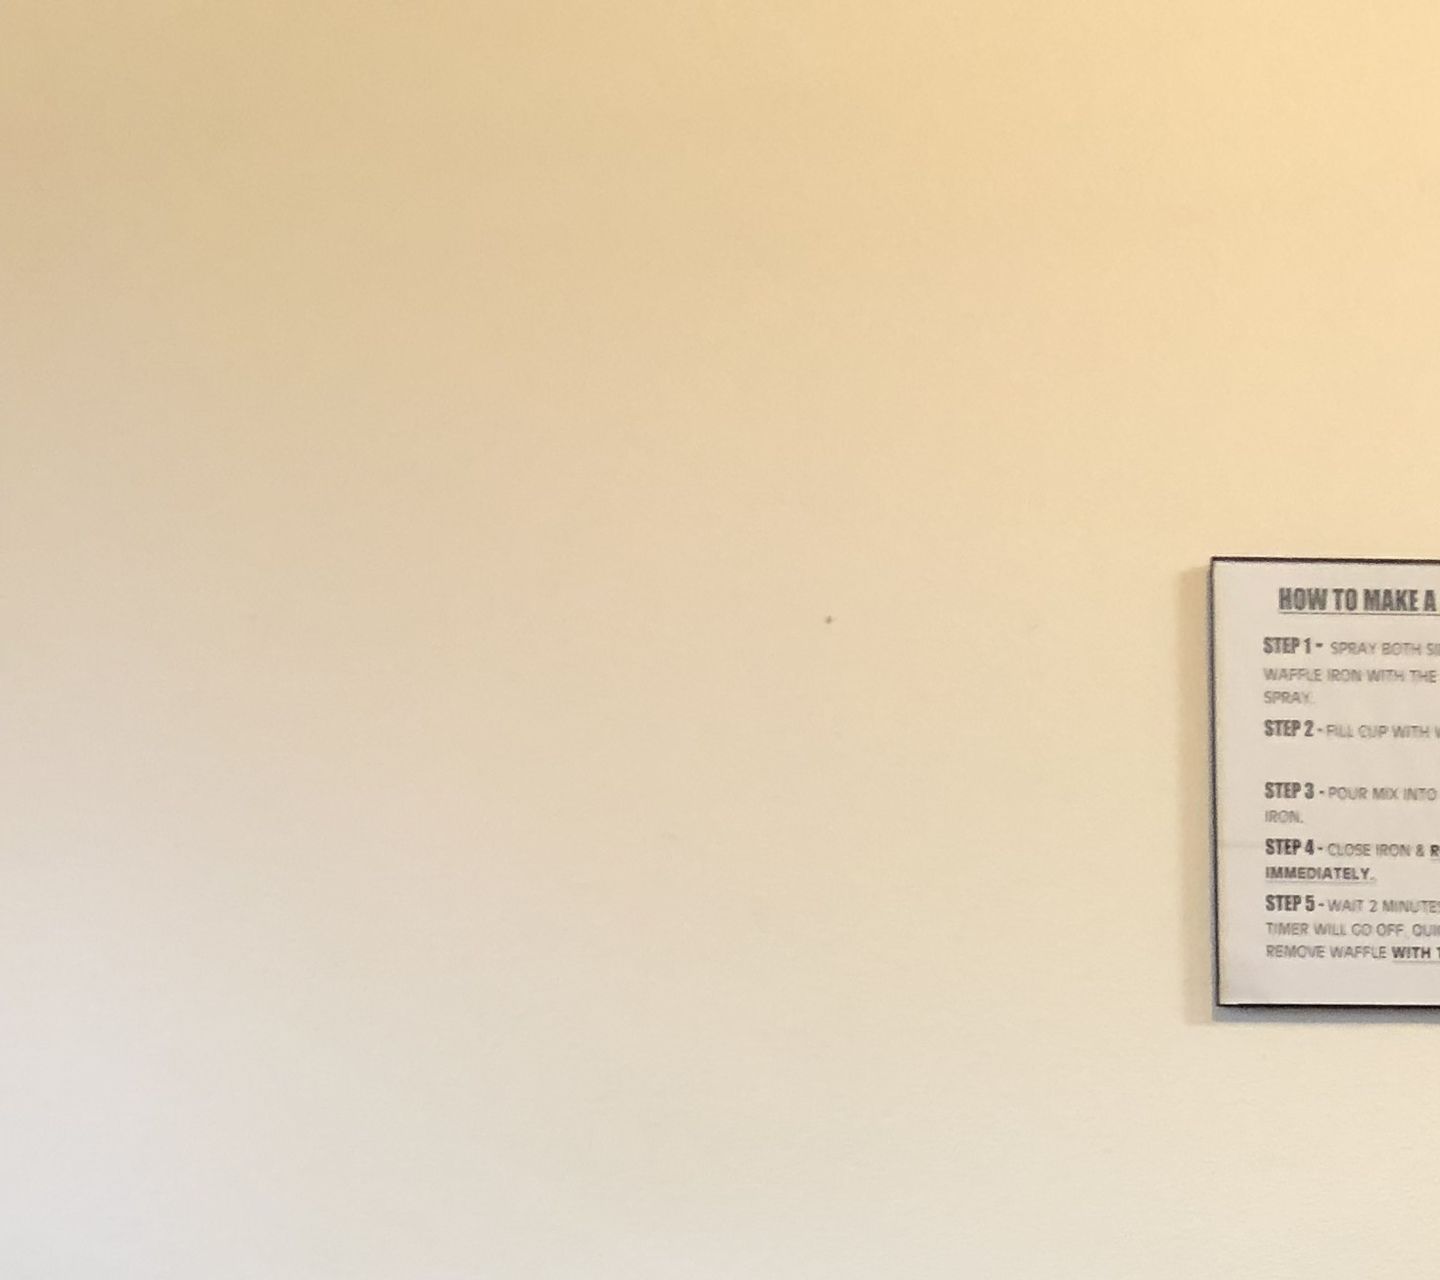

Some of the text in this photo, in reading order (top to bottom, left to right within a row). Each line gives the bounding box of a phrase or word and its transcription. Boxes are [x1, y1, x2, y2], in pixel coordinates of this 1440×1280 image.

[1278, 587, 1328, 611] HOW
[1333, 588, 1357, 611] TO
[1363, 588, 1418, 612] MAKE
[1423, 589, 1437, 612] A
[1263, 637, 1300, 654] STEP
[1304, 637, 1312, 654] 1
[1330, 641, 1377, 656] SPRAY
[1382, 642, 1422, 657] BOTH
[1263, 668, 1322, 682] WAFFLE
[1327, 668, 1362, 682] IRON
[1367, 669, 1405, 683] WITH
[1409, 669, 1437, 683] THE
[1264, 719, 1301, 737] STEP
[1304, 719, 1314, 737] 2
[1326, 724, 1355, 738] FILL
[1358, 724, 1388, 738] CUP
[1392, 725, 1430, 738] WITH
[1265, 782, 1301, 799] STEP
[1305, 782, 1314, 799] 3
[1328, 787, 1367, 800] POUR
[1373, 787, 1399, 800] MIX
[1403, 787, 1437, 801] INTO
[1265, 810, 1303, 824] IRON.
[1265, 838, 1302, 855] STEP
[1304, 839, 1315, 856] 4
[1327, 843, 1370, 857] CLOSE
[1375, 844, 1411, 857] IRON
[1415, 844, 1425, 857] &
[1265, 866, 1375, 881] IMMEDIATELY.
[1265, 895, 1302, 912] STEP
[1305, 895, 1315, 912] 5
[1328, 899, 1363, 913] WAIT
[1369, 900, 1378, 913] 2
[1266, 922, 1309, 936] TIMER
[1314, 922, 1347, 936] WILL
[1351, 923, 1372, 936] GO
[1266, 944, 1325, 958] REMOVE
[1330, 945, 1387, 959] WAFFLE
[1392, 946, 1431, 959] WITH
